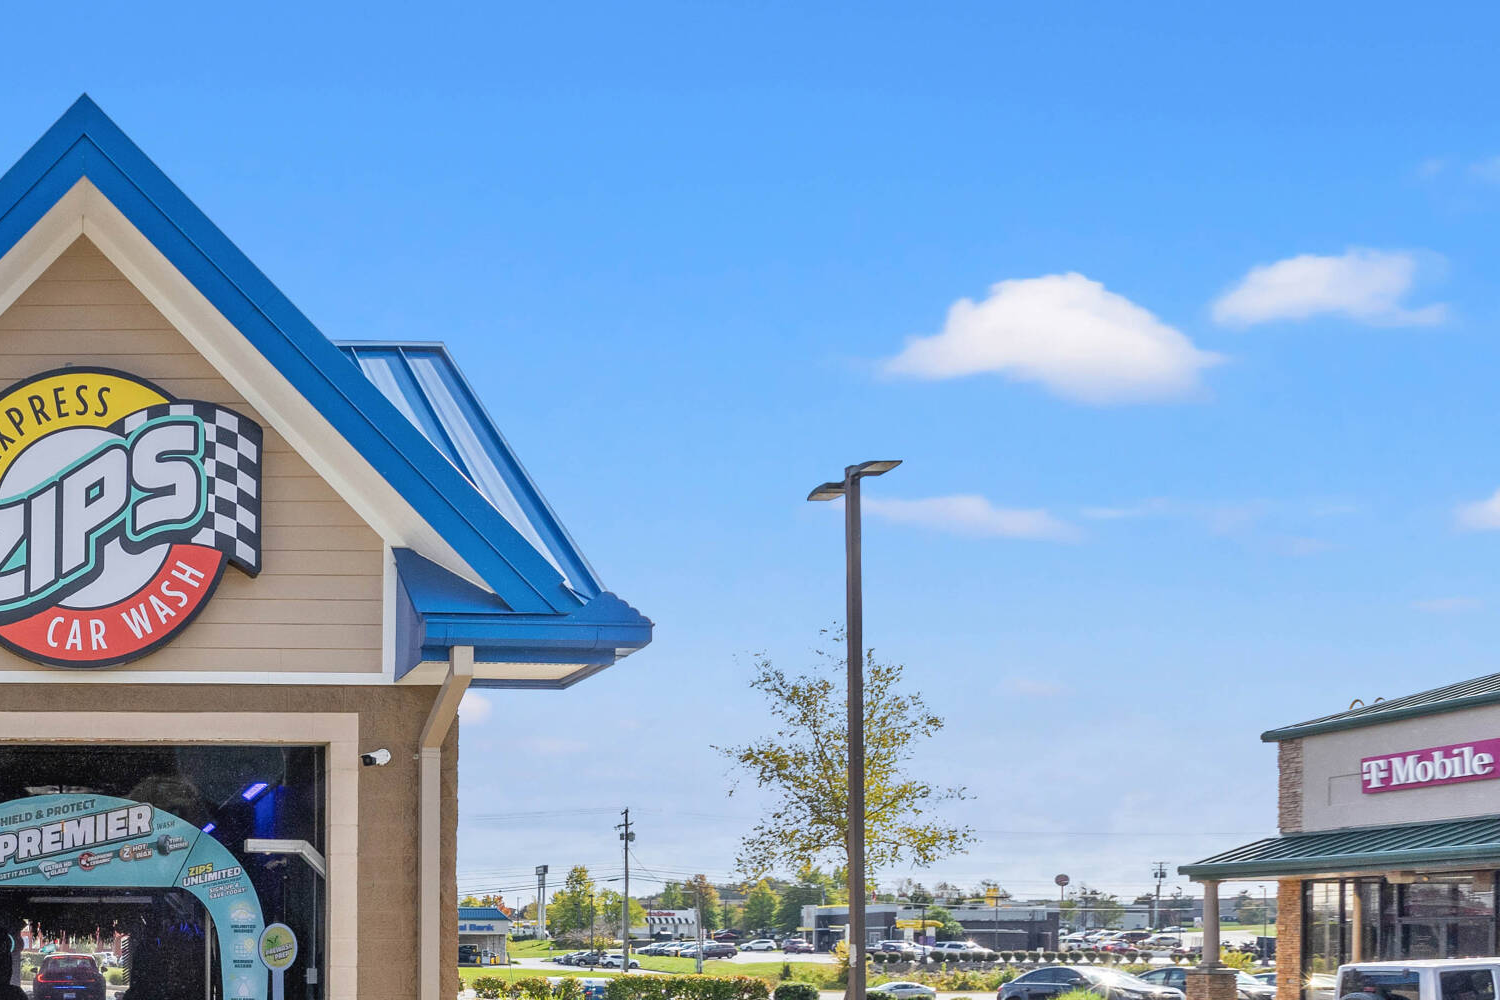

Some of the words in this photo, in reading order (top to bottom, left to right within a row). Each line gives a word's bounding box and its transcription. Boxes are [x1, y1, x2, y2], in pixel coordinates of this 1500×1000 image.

[46, 616, 108, 651] CAR
[121, 559, 206, 640] WASH
[35, 808, 45, 819] &
[46, 799, 96, 818] PROTECT
[156, 820, 176, 831] WASH
[132, 844, 148, 852] HOT
[182, 866, 242, 888] UNLIMITED
[188, 862, 214, 876] ZIPS
